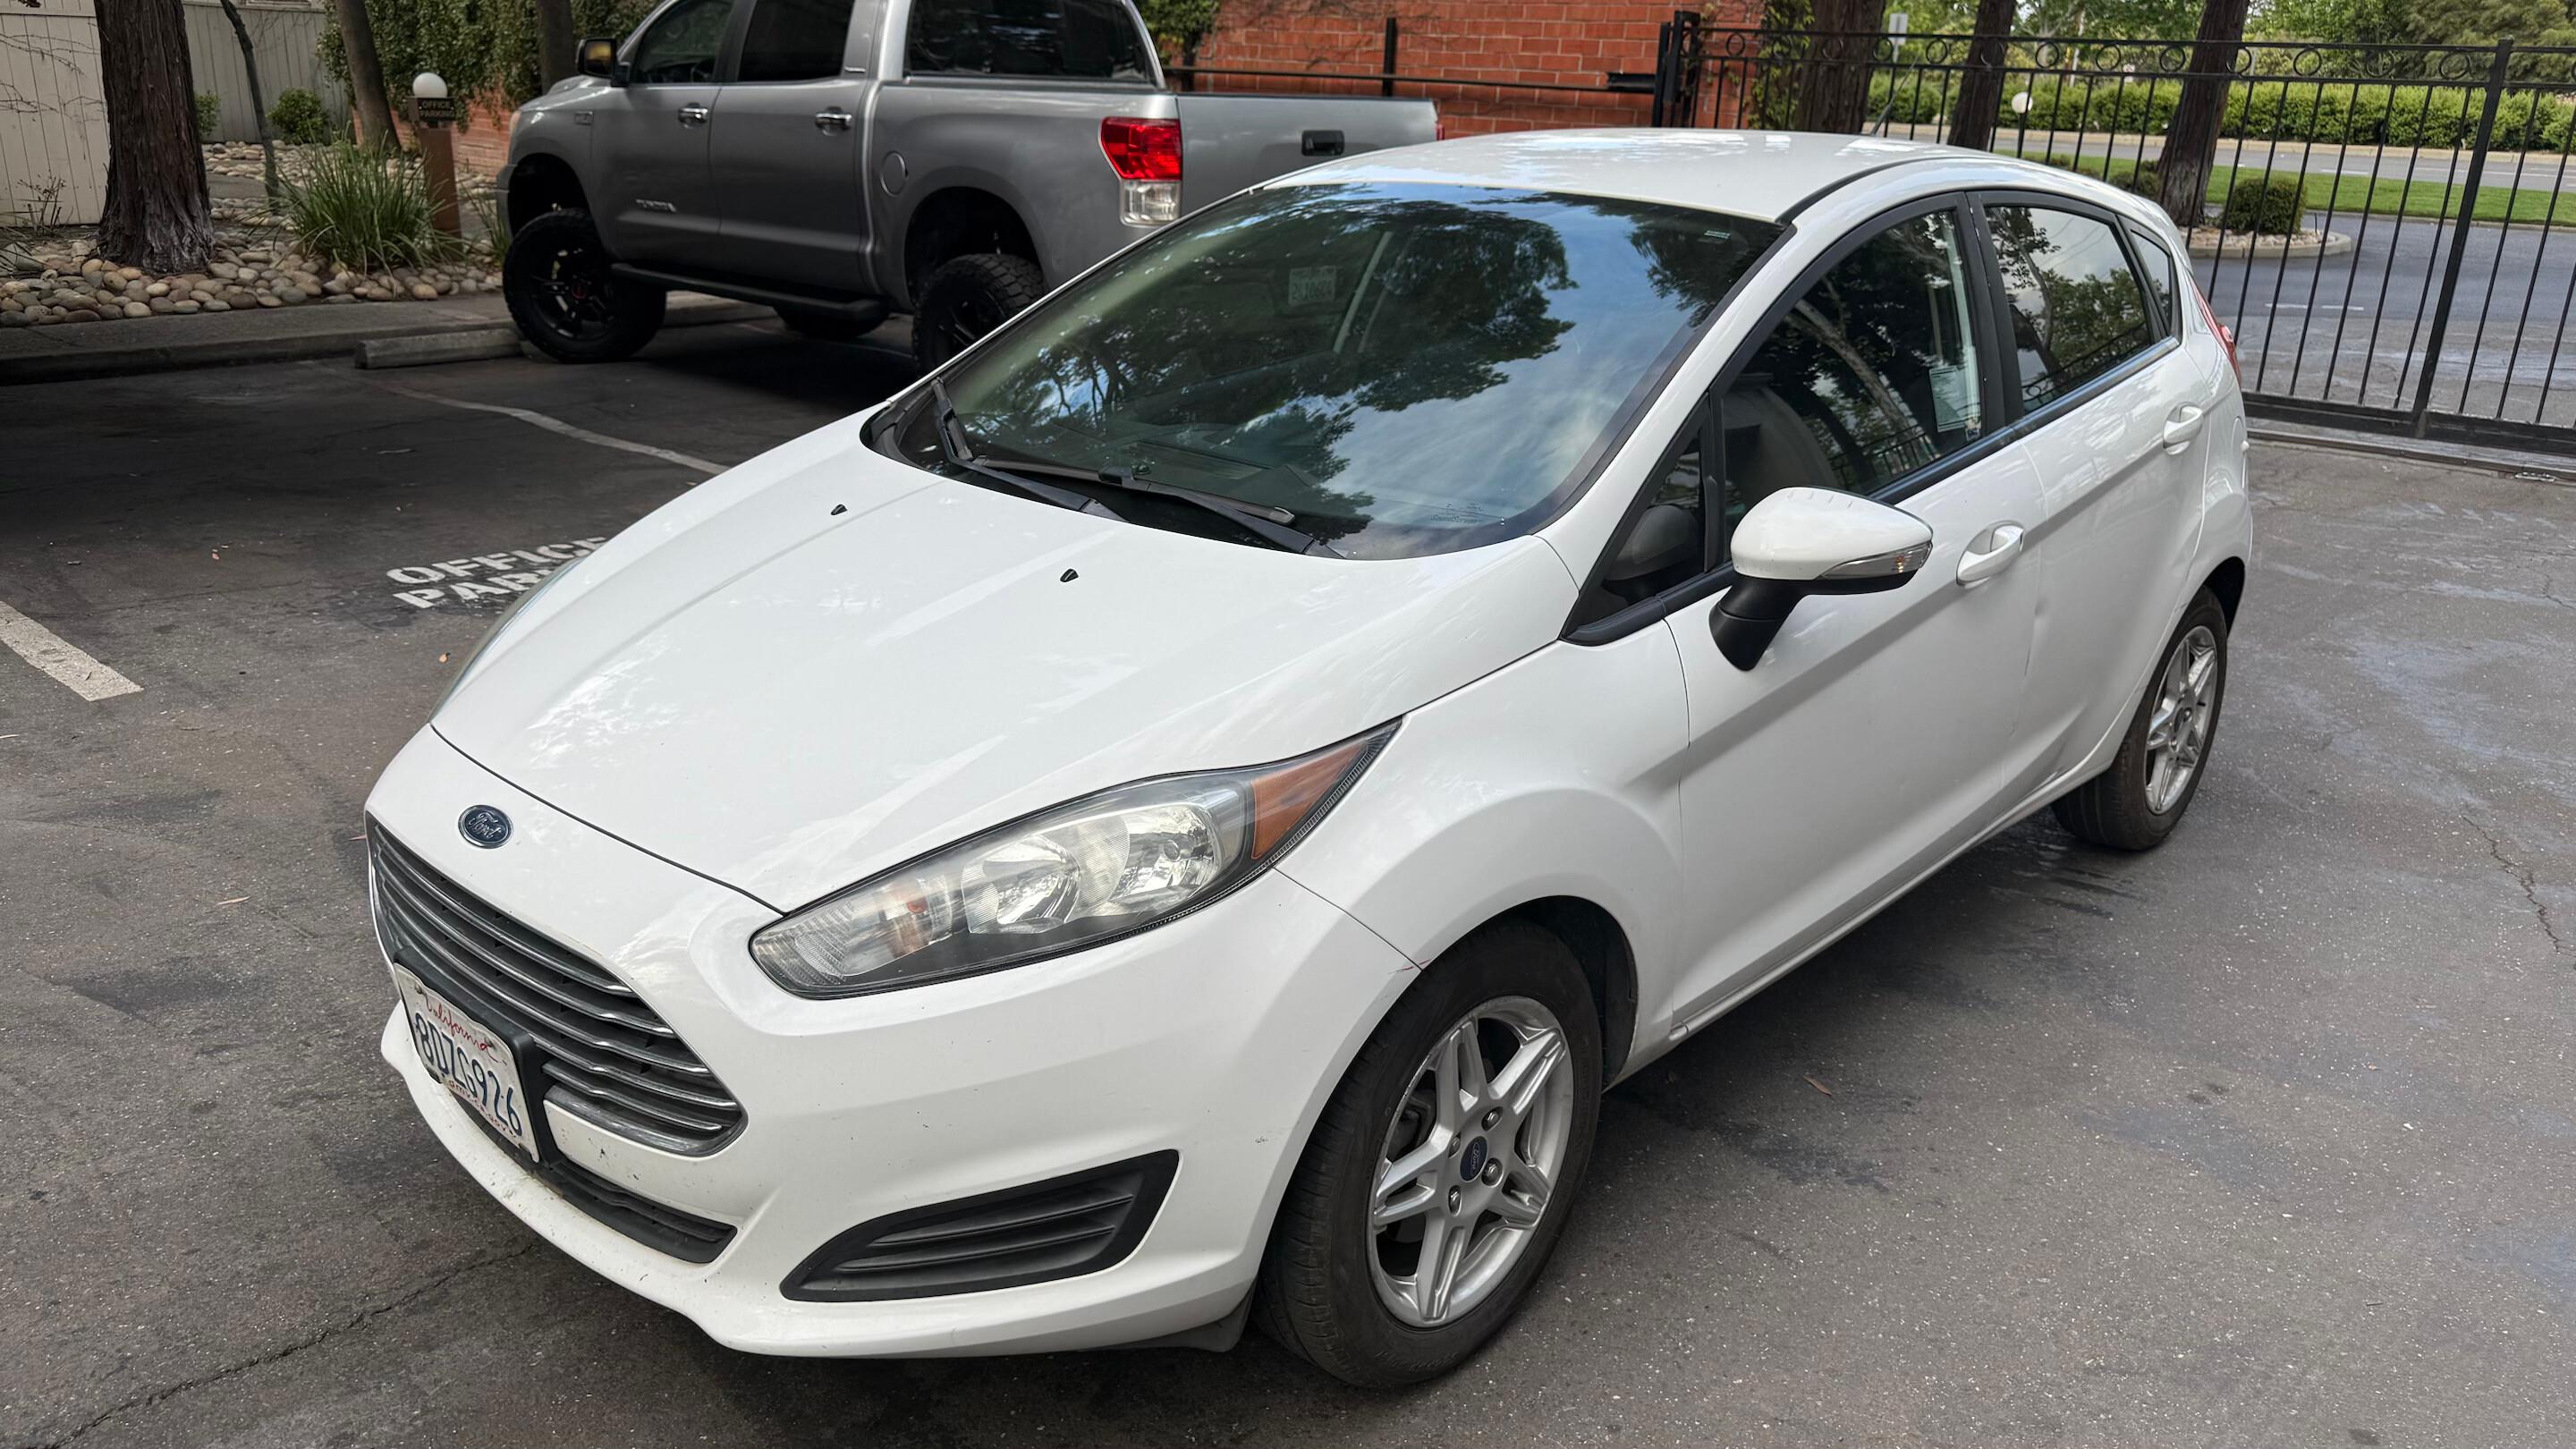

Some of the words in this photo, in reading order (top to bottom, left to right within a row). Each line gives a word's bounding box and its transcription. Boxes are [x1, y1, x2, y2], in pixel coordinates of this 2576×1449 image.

[422, 100, 451, 108] OFFICE
[394, 570, 552, 608] PAR
[469, 811, 502, 838] Ford
[414, 1013, 522, 1136] 8DZG926
